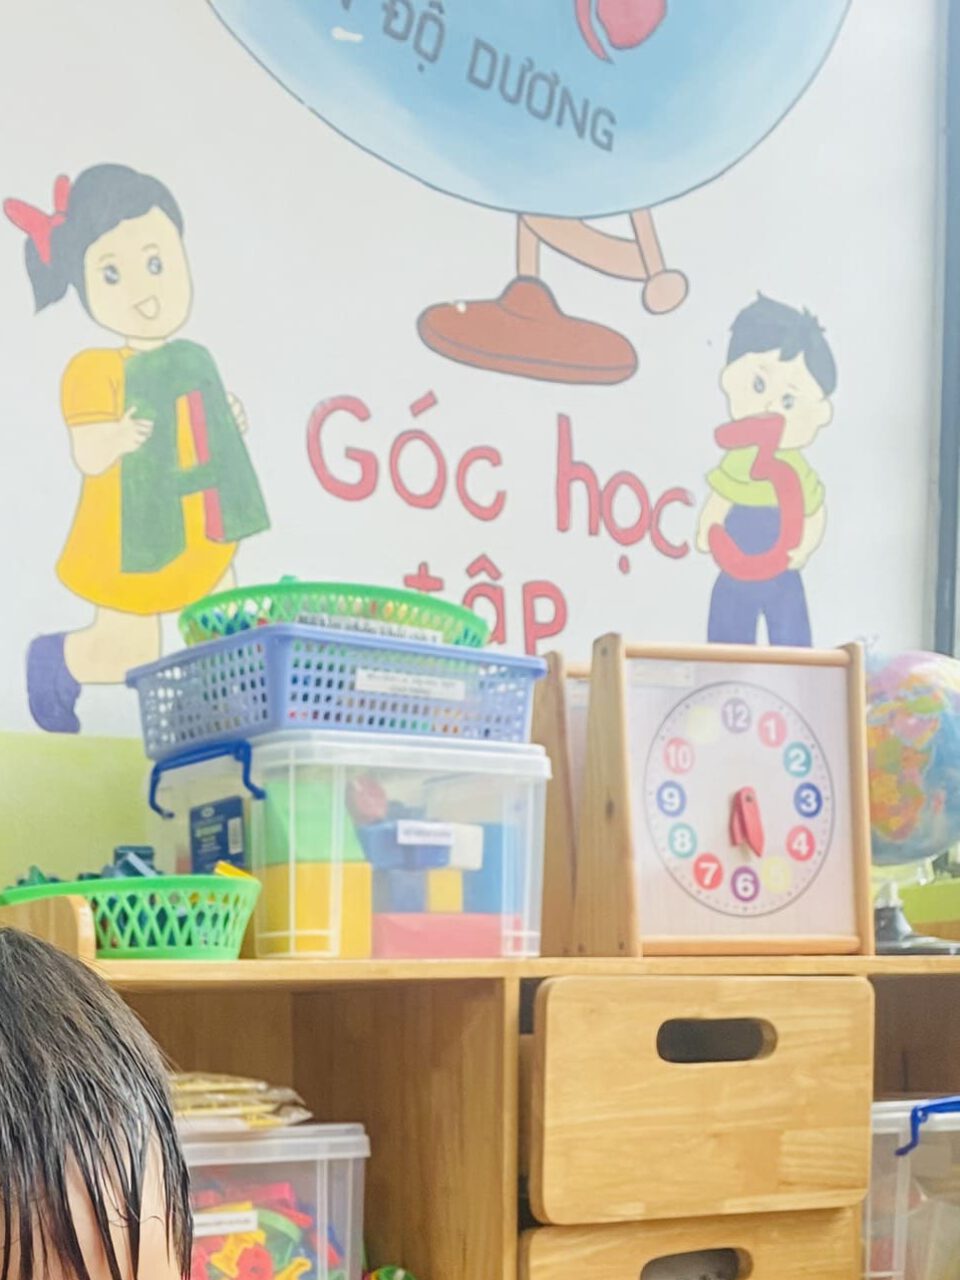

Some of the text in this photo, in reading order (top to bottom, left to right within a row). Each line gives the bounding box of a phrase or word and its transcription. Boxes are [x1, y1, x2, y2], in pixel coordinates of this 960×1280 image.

[466, 36, 618, 152] DƯƠNG
[306, 390, 695, 574] Góc học
[723, 703, 750, 729] 12
[667, 743, 691, 770] 10
[790, 747, 808, 773] 2
[662, 786, 681, 812] 9
[799, 787, 817, 813] 3
[674, 828, 692, 854] 8
[791, 832, 810, 857] 4
[698, 860, 719, 886] 7
[736, 872, 754, 898] 6
